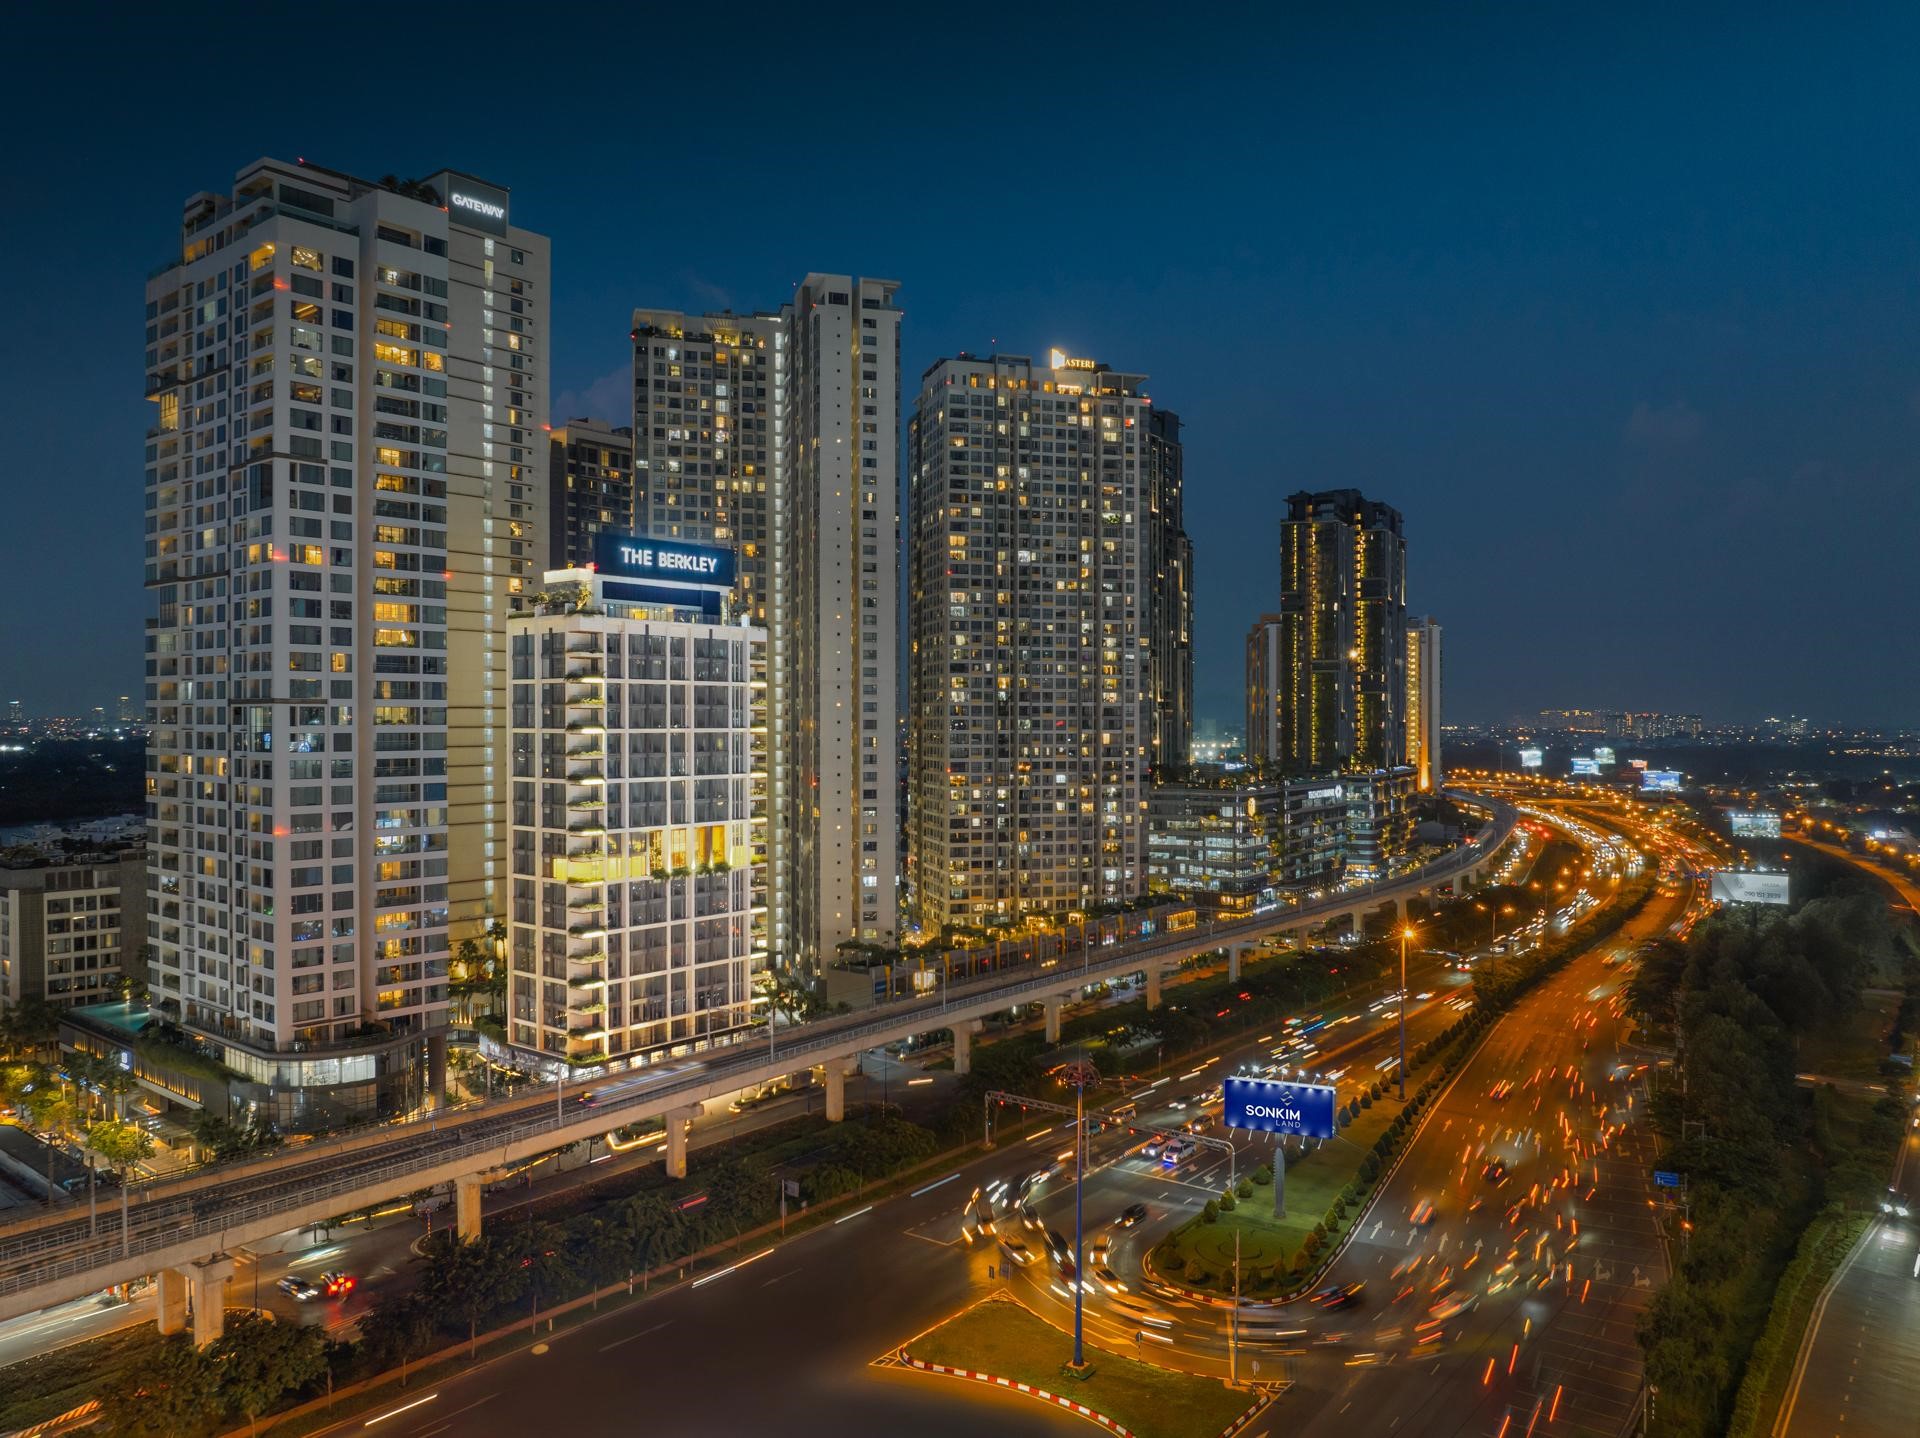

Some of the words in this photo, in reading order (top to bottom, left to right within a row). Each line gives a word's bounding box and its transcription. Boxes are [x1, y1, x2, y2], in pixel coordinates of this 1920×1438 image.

[452, 193, 504, 218] GATEWAY
[621, 547, 653, 566] THE
[658, 552, 717, 573] BERKLEY
[1245, 1104, 1301, 1121] SONKIM
[1275, 1119, 1301, 1128] LAND
